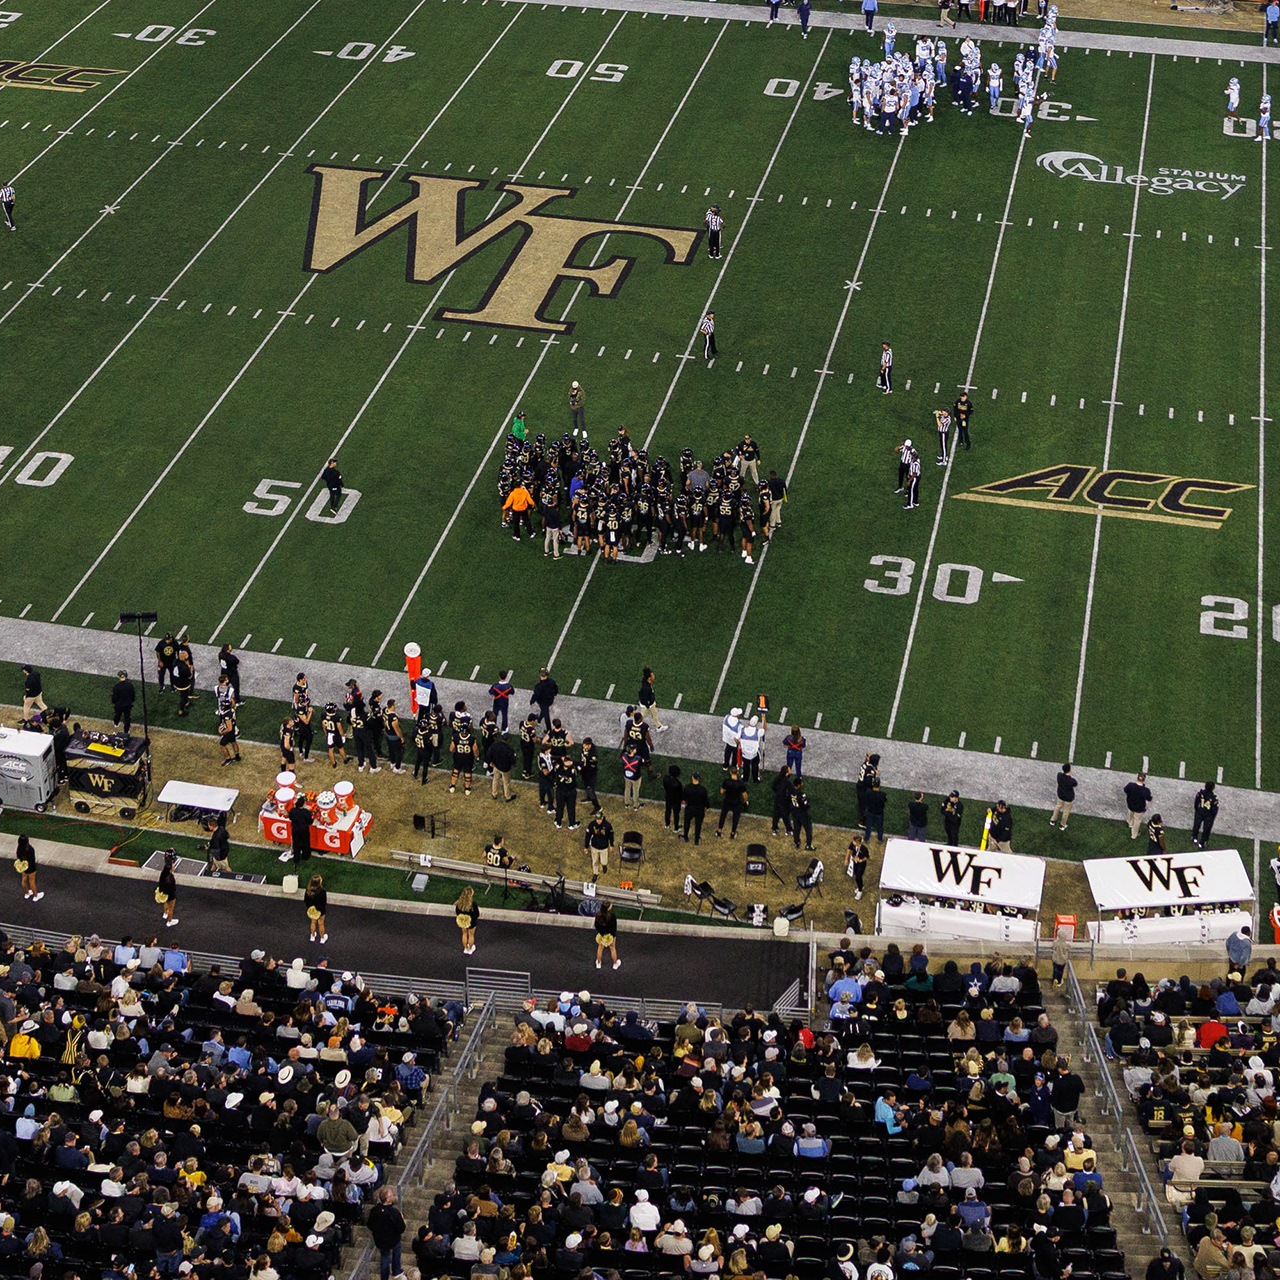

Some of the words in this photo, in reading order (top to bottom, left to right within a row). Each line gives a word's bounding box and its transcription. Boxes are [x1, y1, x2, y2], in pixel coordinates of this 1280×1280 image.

[134, 24, 217, 47] 30
[335, 41, 417, 65] 40
[544, 59, 630, 84] 50
[762, 78, 845, 102] 40
[1057, 158, 1247, 201] Allegacy
[1158, 166, 1248, 182] STADIUM
[302, 162, 706, 336] WF
[242, 477, 363, 524] 50
[960, 462, 1258, 523] ACC
[576, 509, 588, 521] 44
[719, 505, 732, 516] 55
[607, 520, 619, 531] 40
[863, 553, 984, 606] 30
[758, 694, 767, 708] 1
[3, 760, 27, 770] ACC
[87, 773, 115, 793] WF
[270, 822, 288, 839] G
[323, 831, 341, 848] G
[485, 852, 501, 867] 90
[928, 847, 1003, 896] WF
[1126, 856, 1206, 900] WF
